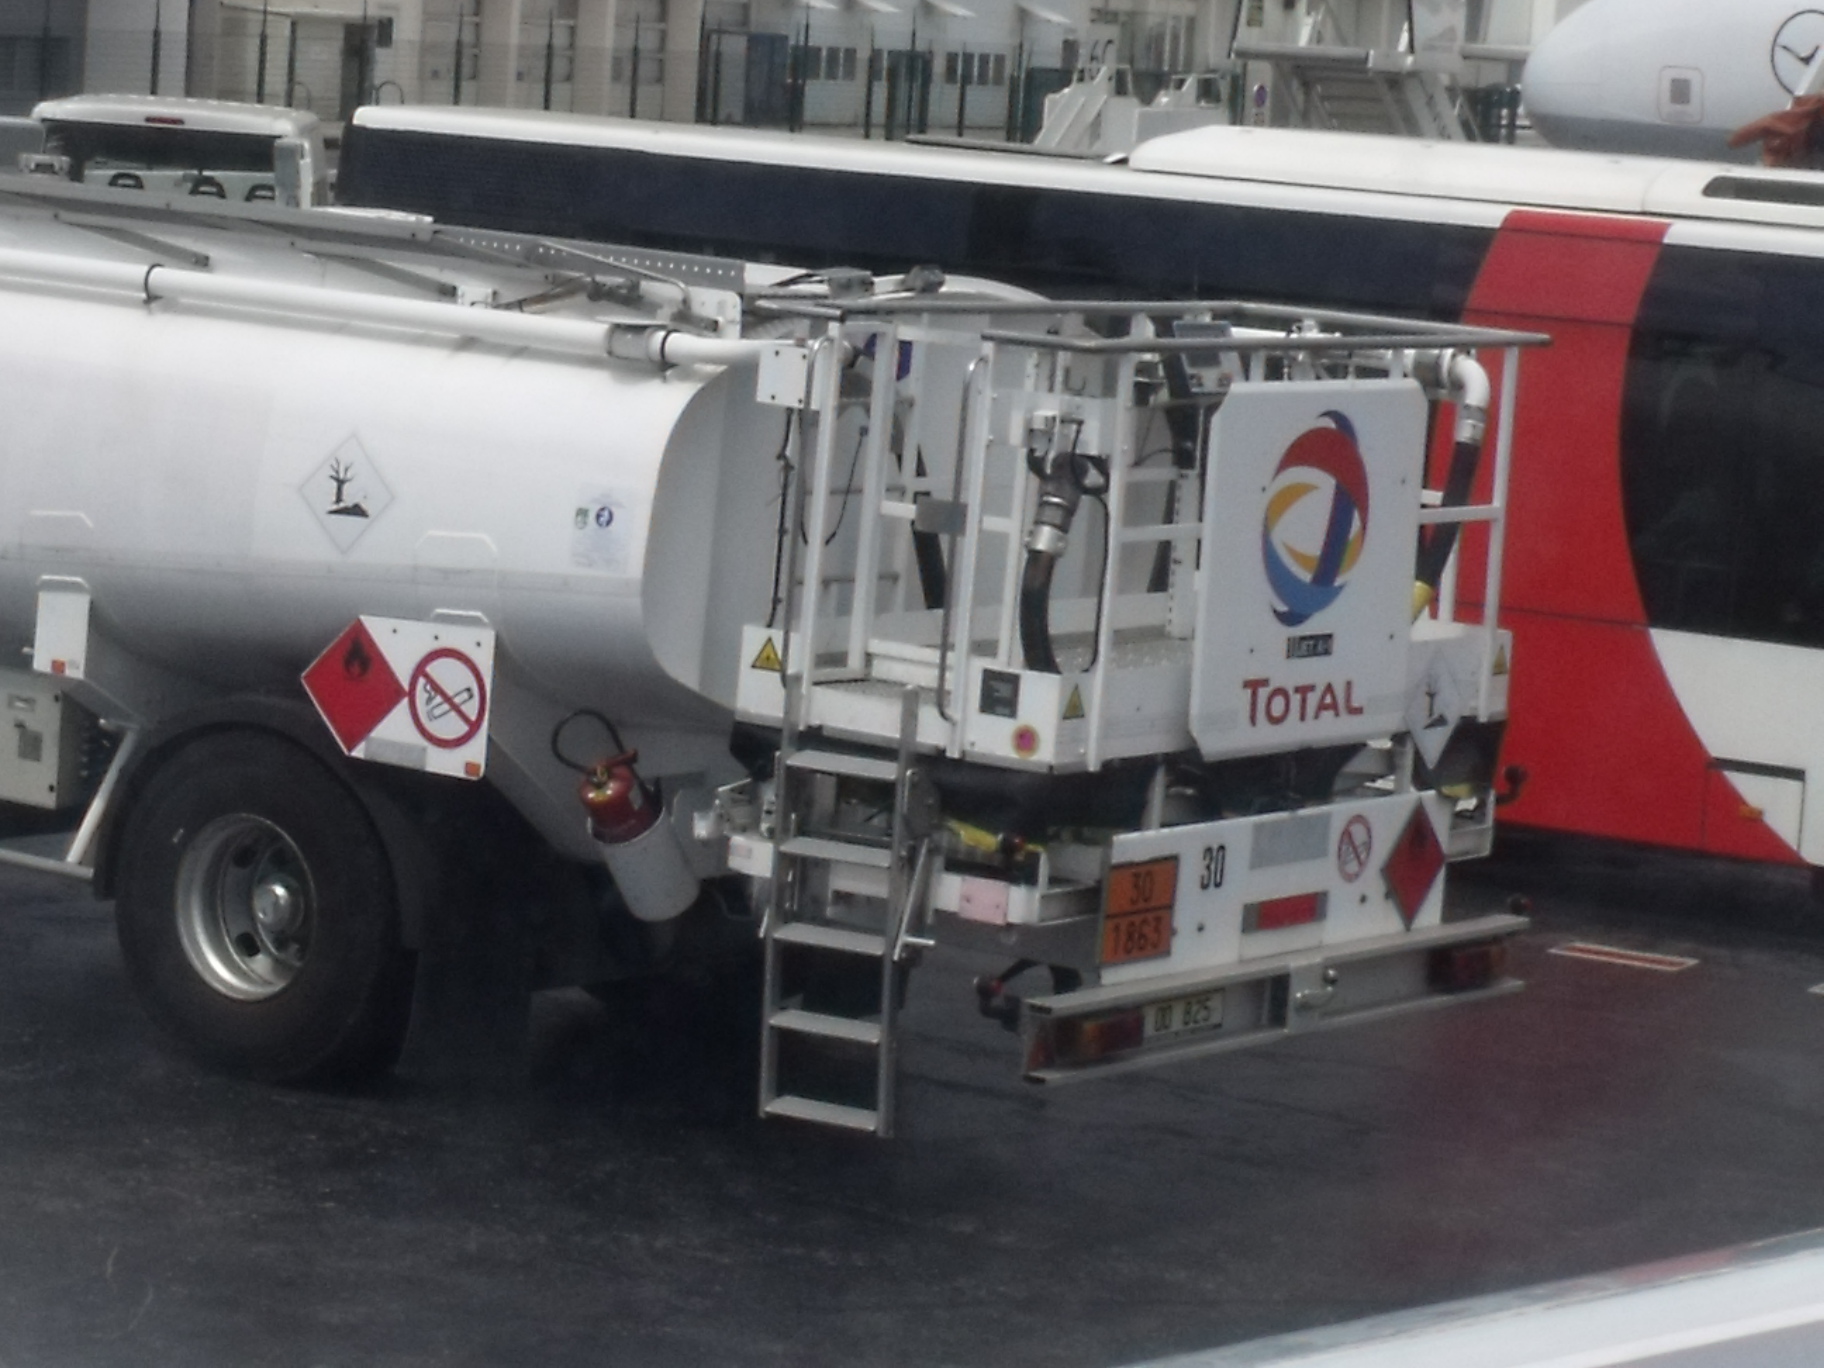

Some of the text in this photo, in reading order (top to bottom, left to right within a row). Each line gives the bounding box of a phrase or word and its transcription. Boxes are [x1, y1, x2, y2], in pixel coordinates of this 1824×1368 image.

[1242, 678, 1365, 727] TOTAL
[1129, 870, 1155, 906] 30
[1200, 844, 1226, 890] 30
[1111, 915, 1164, 956] 1863
